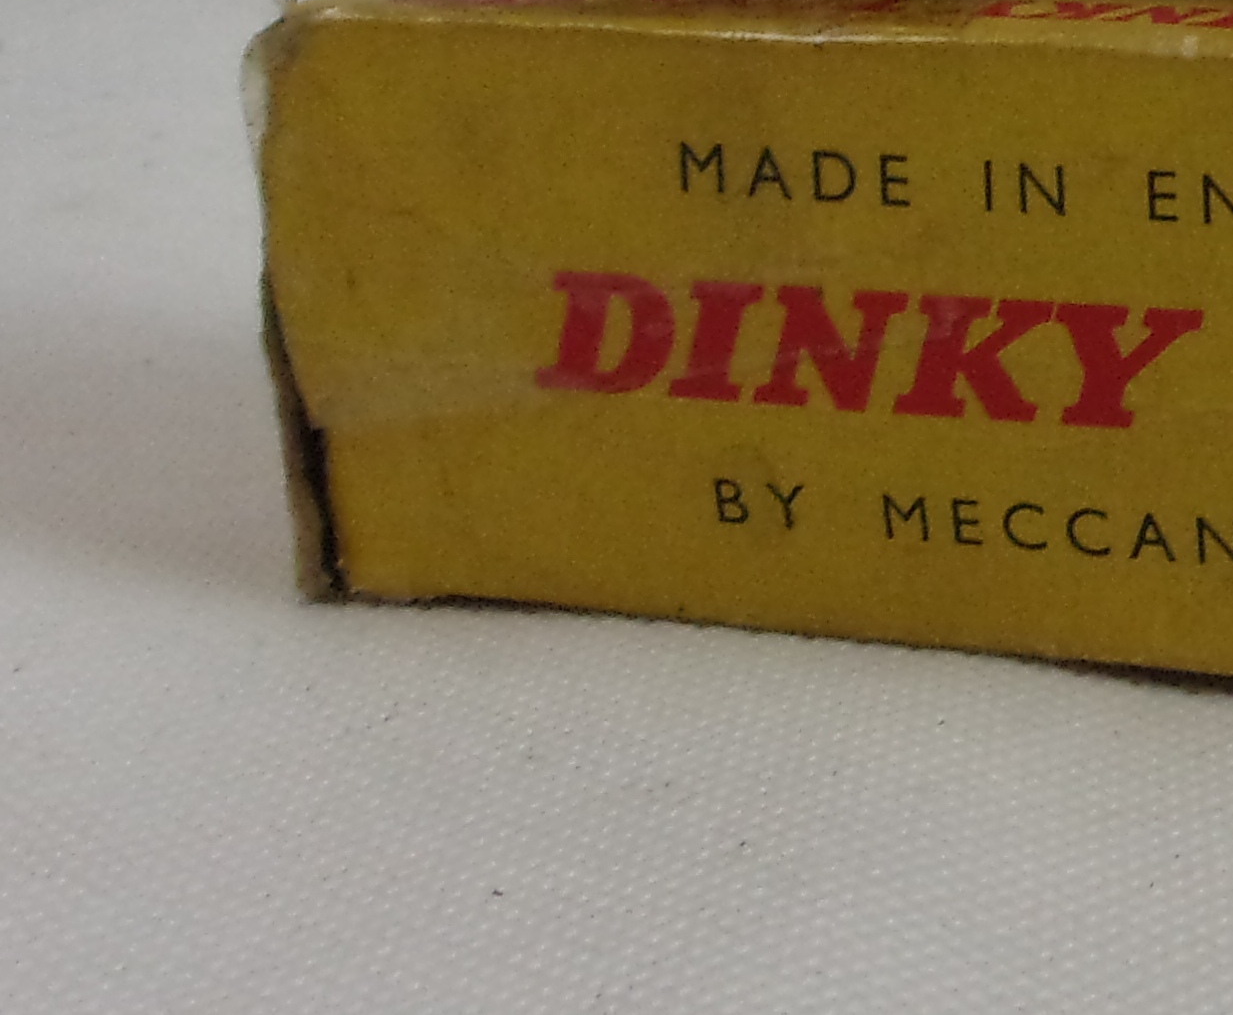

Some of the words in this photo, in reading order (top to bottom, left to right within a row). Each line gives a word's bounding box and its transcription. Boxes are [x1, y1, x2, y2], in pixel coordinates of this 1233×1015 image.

[679, 141, 911, 208] MADE
[983, 159, 1066, 217] IN
[536, 271, 1204, 428] DINKY
[714, 478, 804, 530] BY
